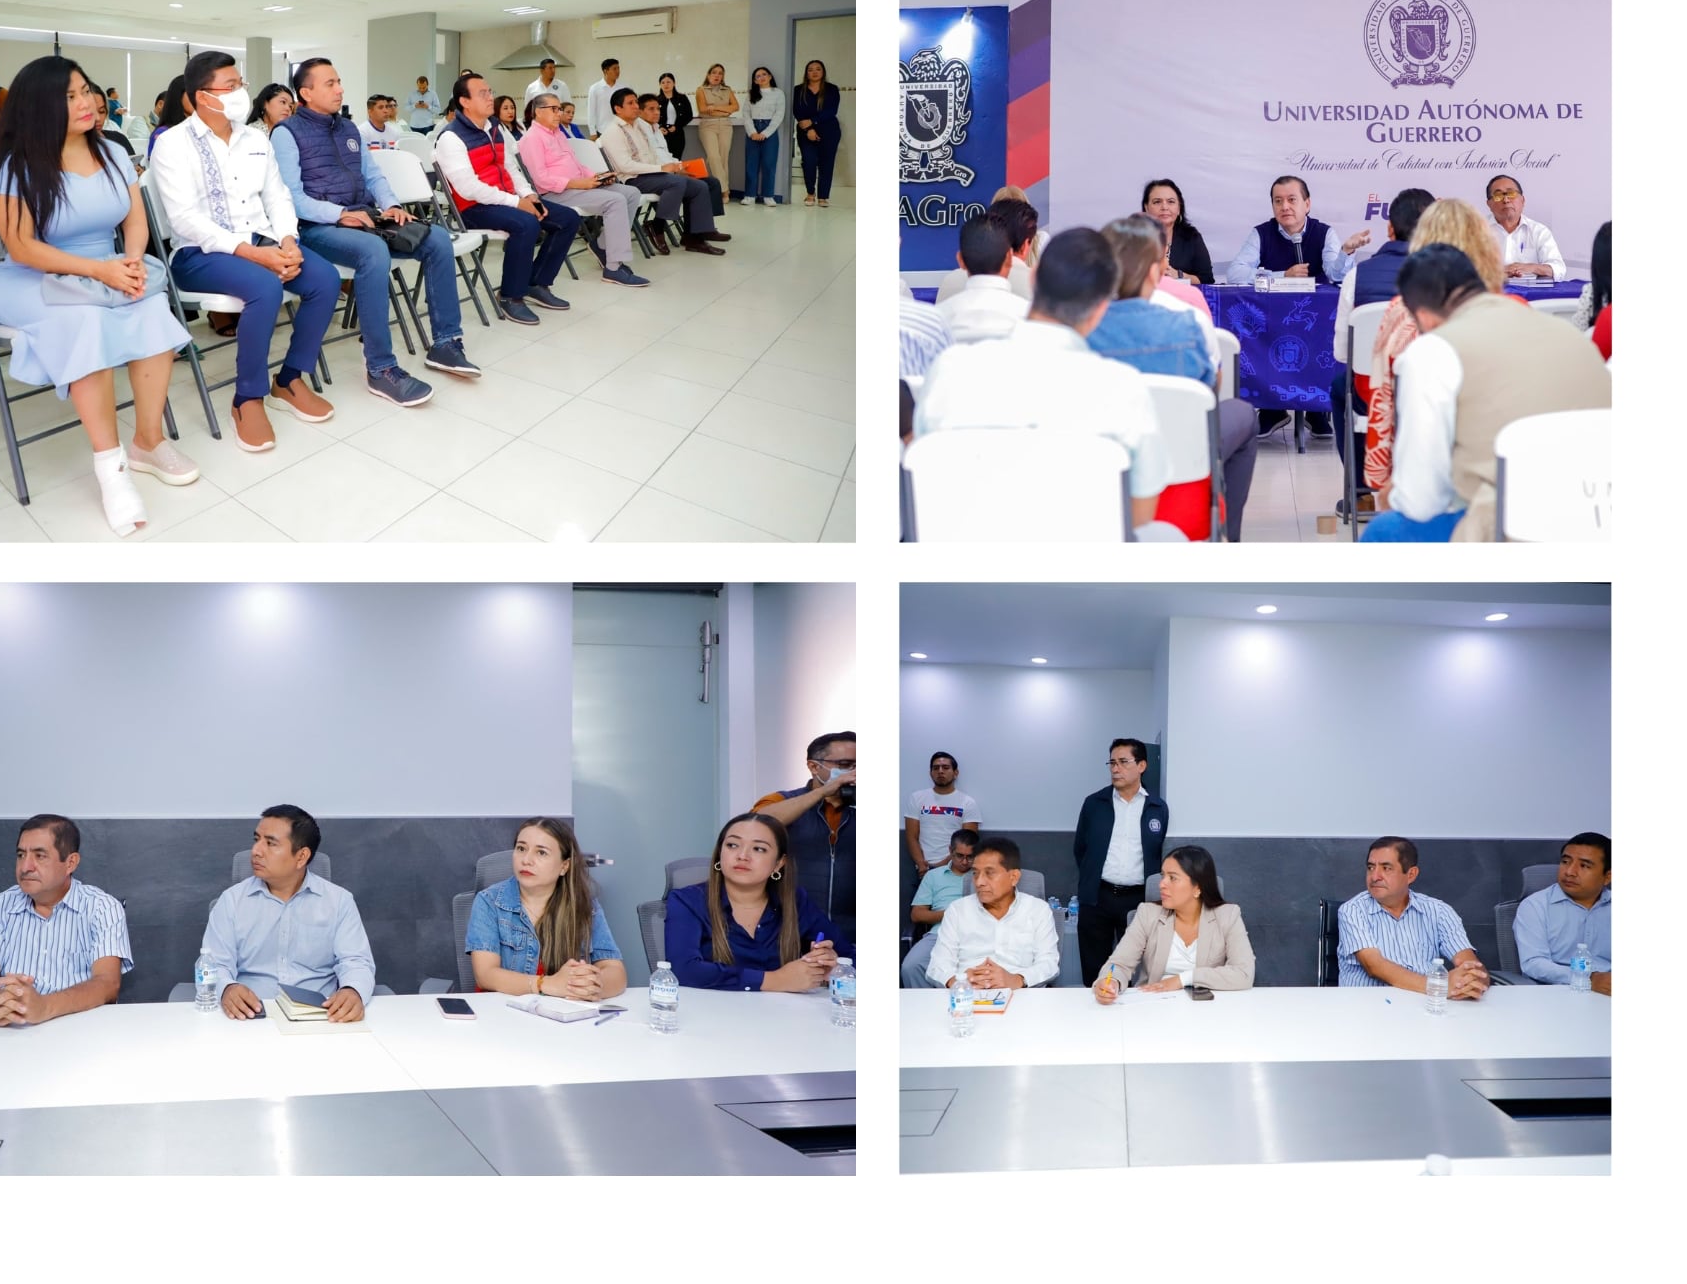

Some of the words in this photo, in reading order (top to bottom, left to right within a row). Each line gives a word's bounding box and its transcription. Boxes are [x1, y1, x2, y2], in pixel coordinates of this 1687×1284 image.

[1451, 1, 1462, 14] DE
[1368, 1, 1389, 72] UNIVERSIDAD
[1451, 18, 1472, 73] GUERRERO
[1263, 101, 1410, 122] UNIVERSIDAD
[1418, 98, 1549, 120] AUTÓNOMA
[1557, 103, 1583, 119] DE
[1366, 122, 1482, 143] GUERRERO
[1367, 158, 1379, 170] de
[1381, 148, 1434, 170] Calidad
[1434, 160, 1453, 169] con
[1368, 193, 1381, 202] EL
